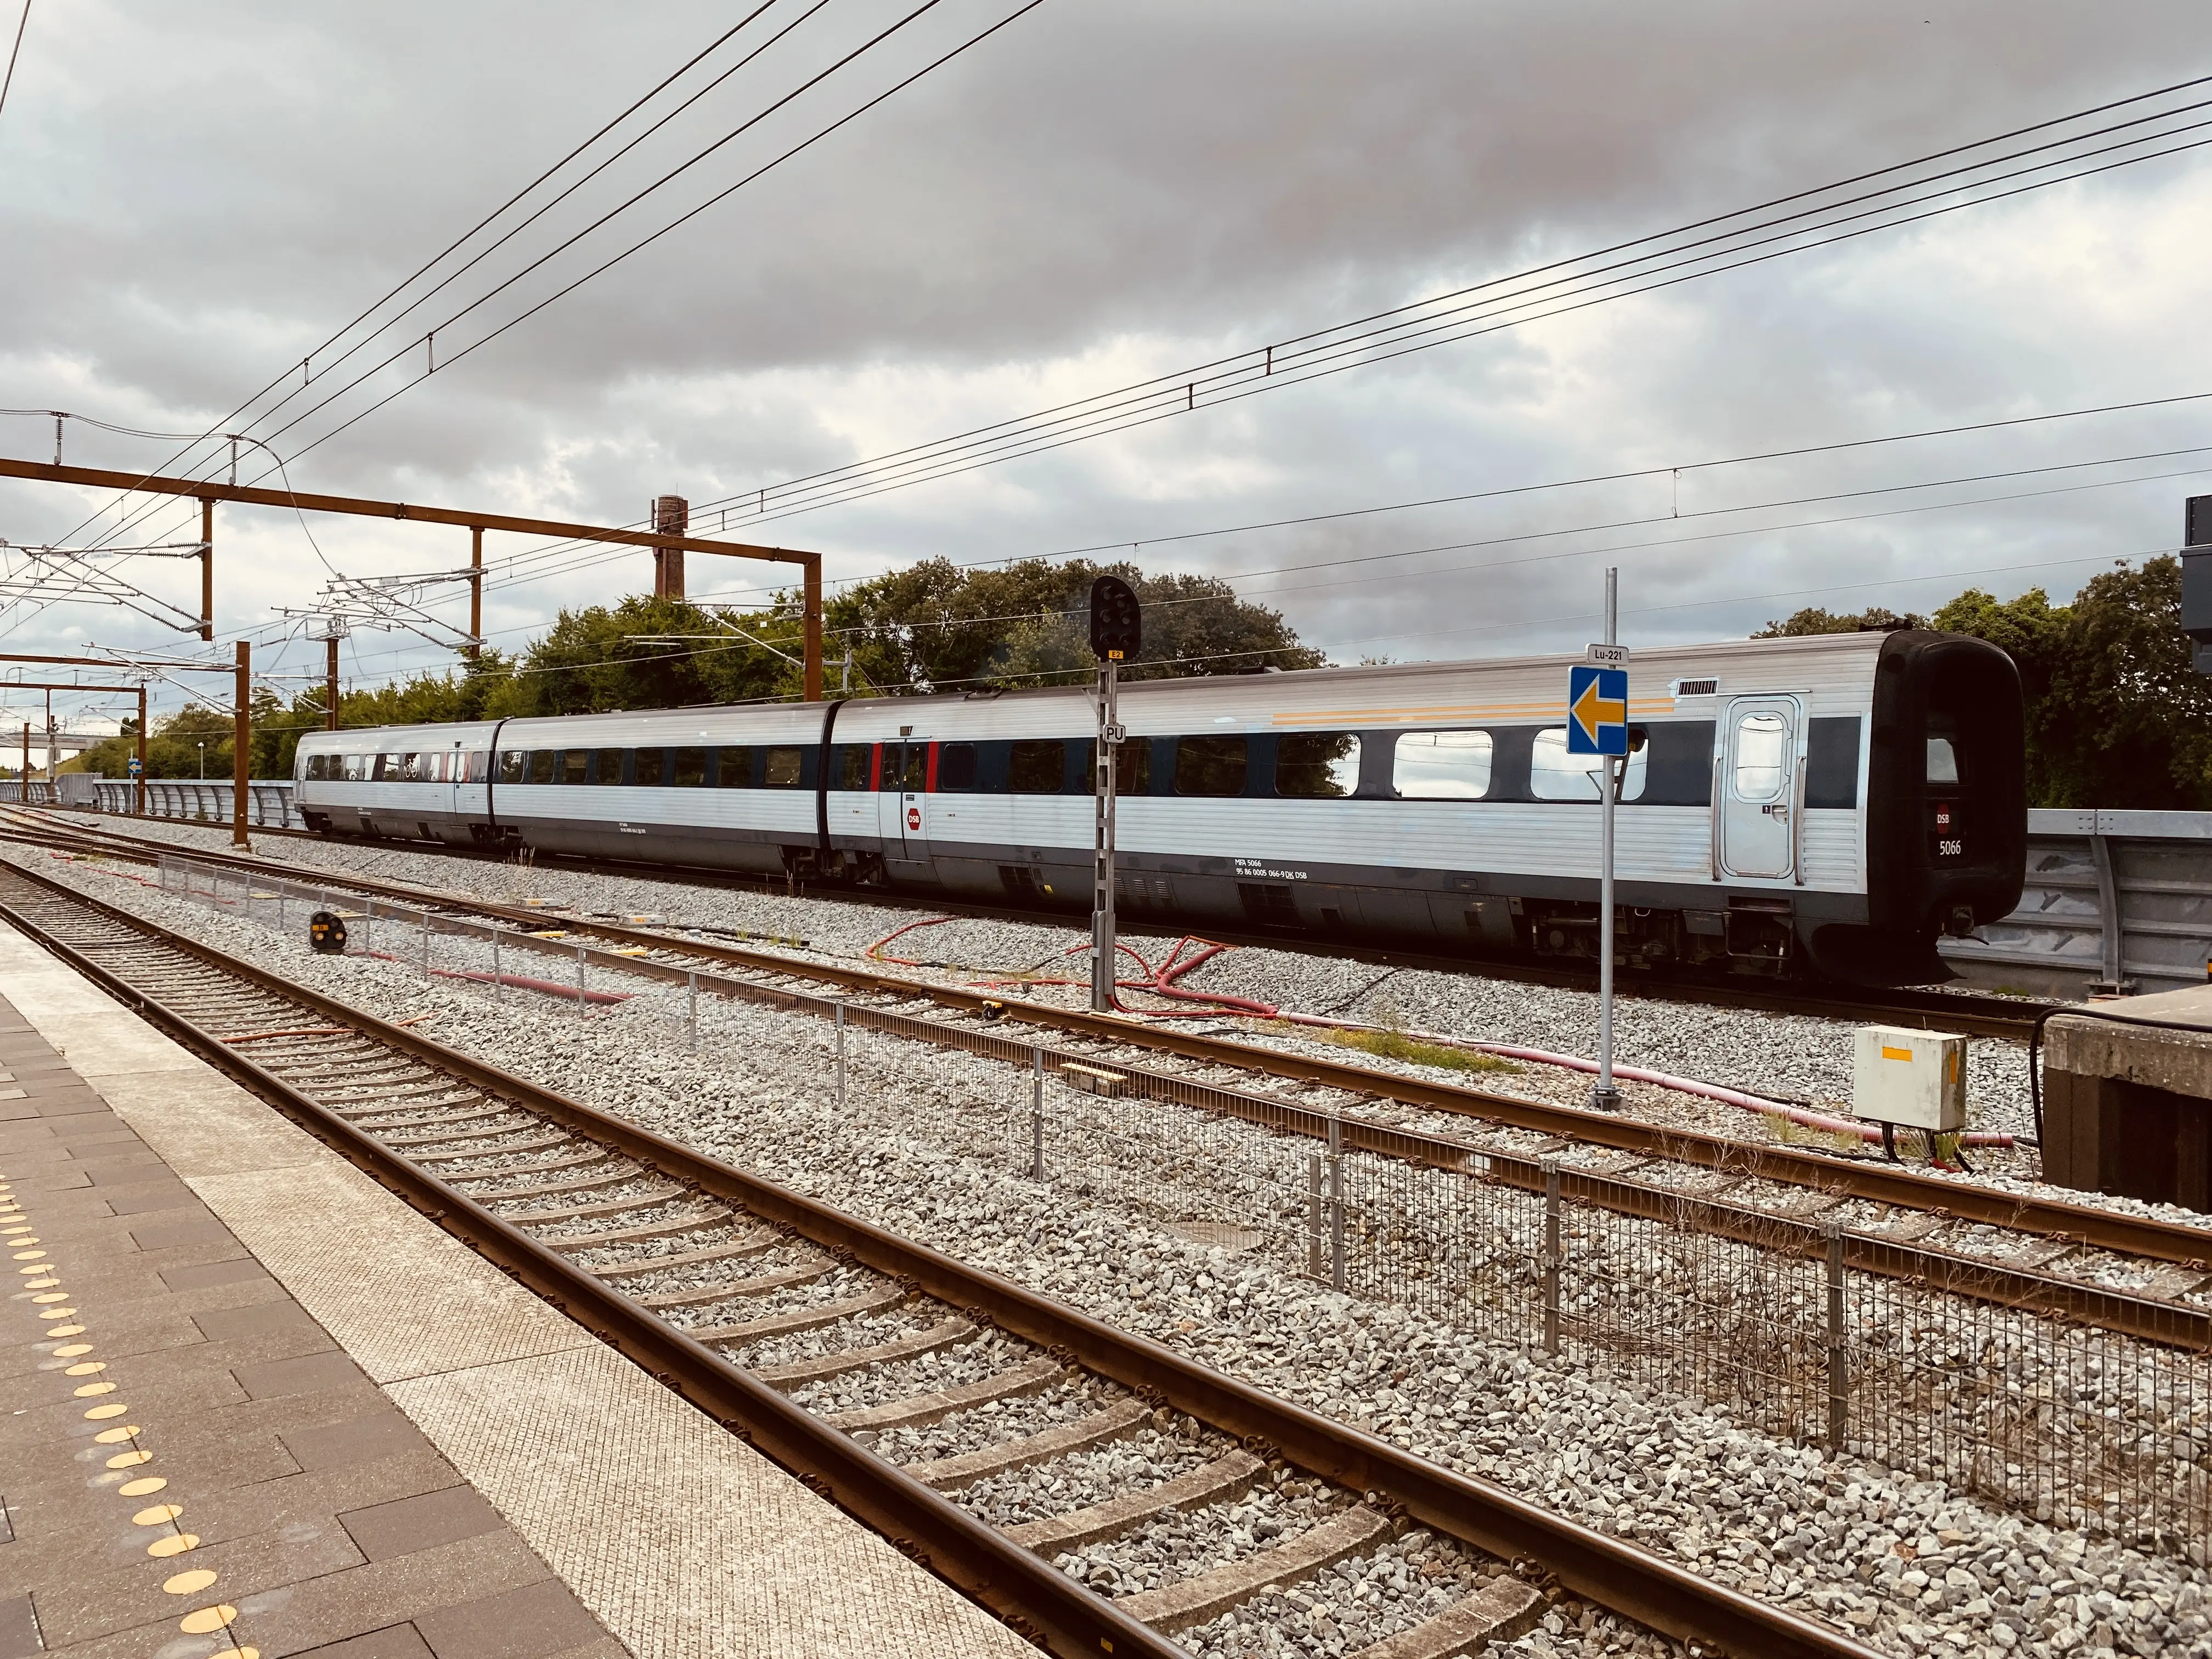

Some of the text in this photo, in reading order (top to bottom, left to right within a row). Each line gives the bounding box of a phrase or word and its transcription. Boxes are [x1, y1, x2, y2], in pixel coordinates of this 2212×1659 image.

[1595, 650, 1622, 660] Lu-221
[1107, 727, 1122, 740] PU
[1937, 814, 1949, 823] DSB
[1940, 840, 1961, 855] 5066
[1285, 871, 1294, 879] DK
